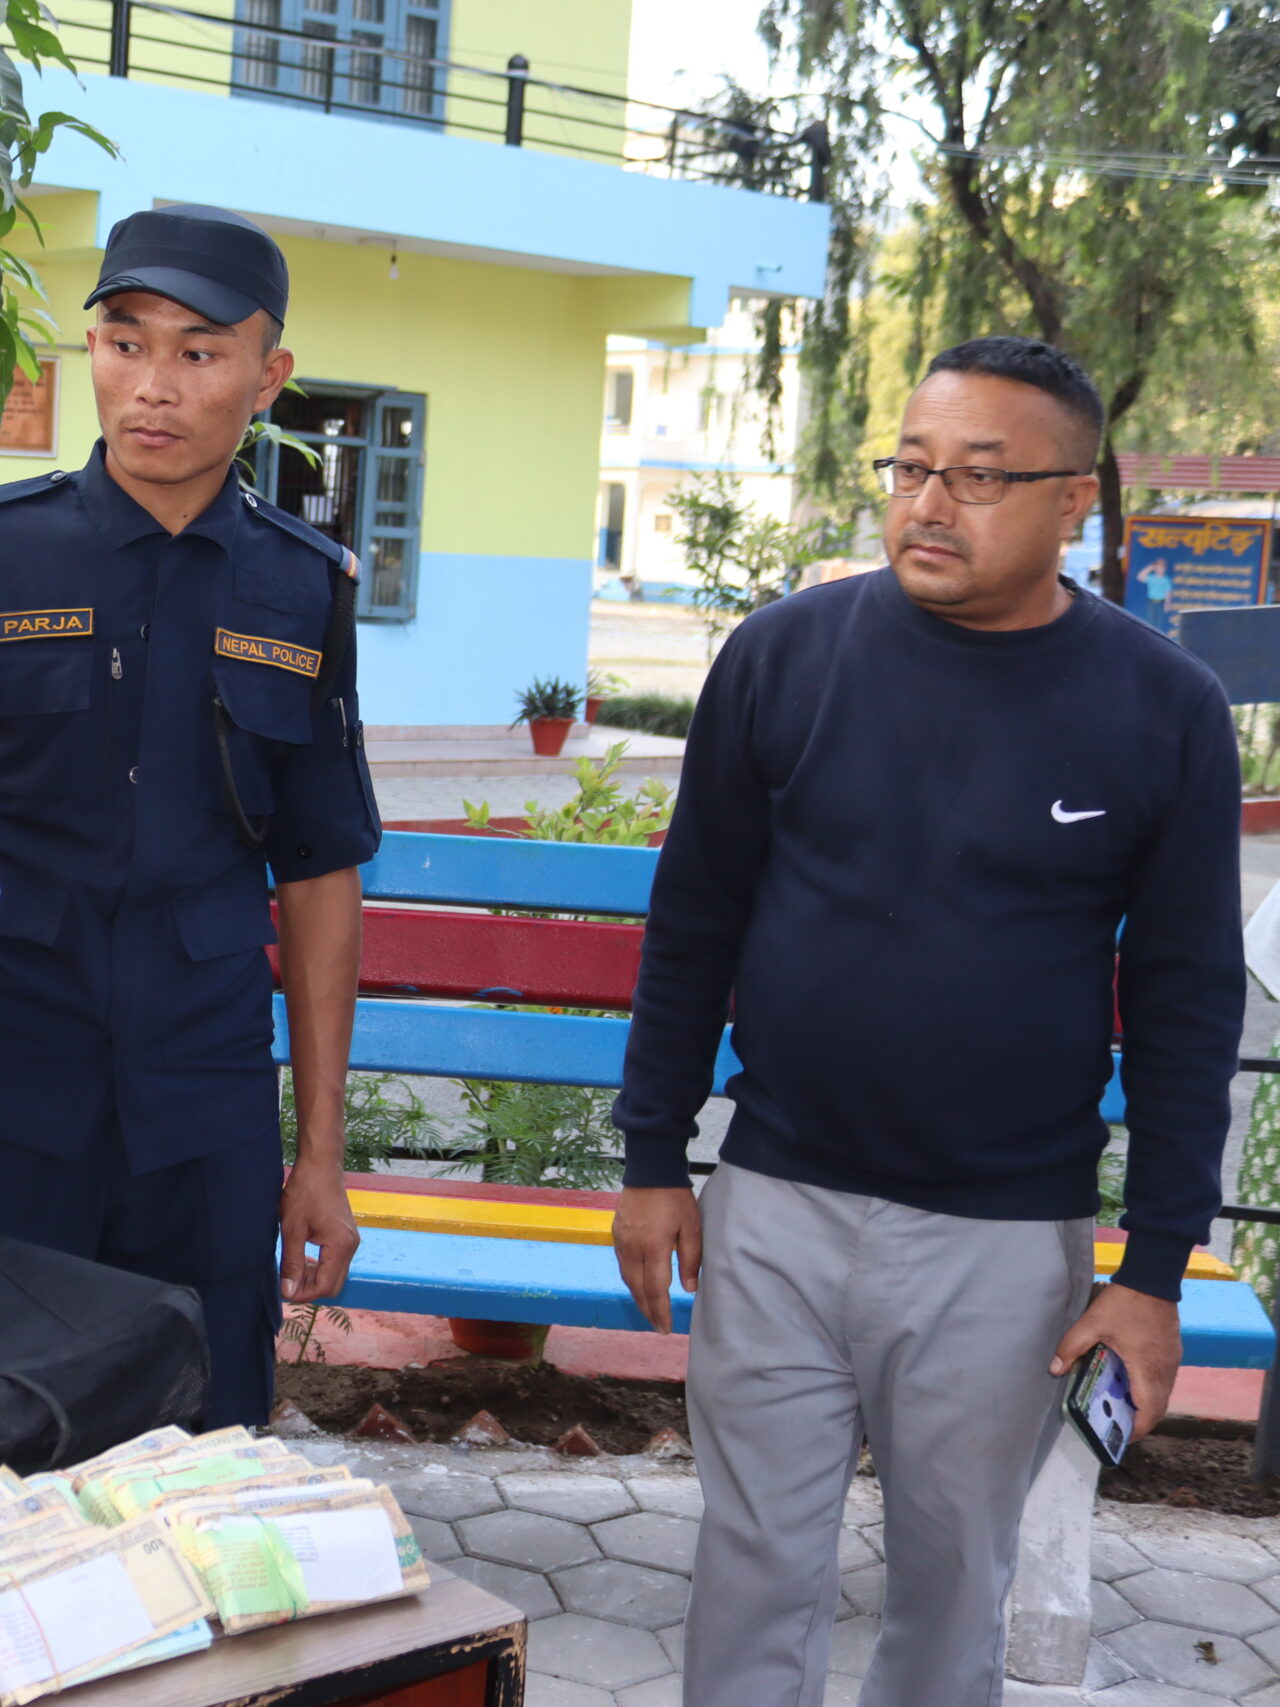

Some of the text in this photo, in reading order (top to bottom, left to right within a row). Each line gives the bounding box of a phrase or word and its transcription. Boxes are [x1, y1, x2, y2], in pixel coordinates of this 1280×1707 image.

[4, 615, 83, 634] PARJA
[223, 636, 315, 670] NEPAL POLICE
